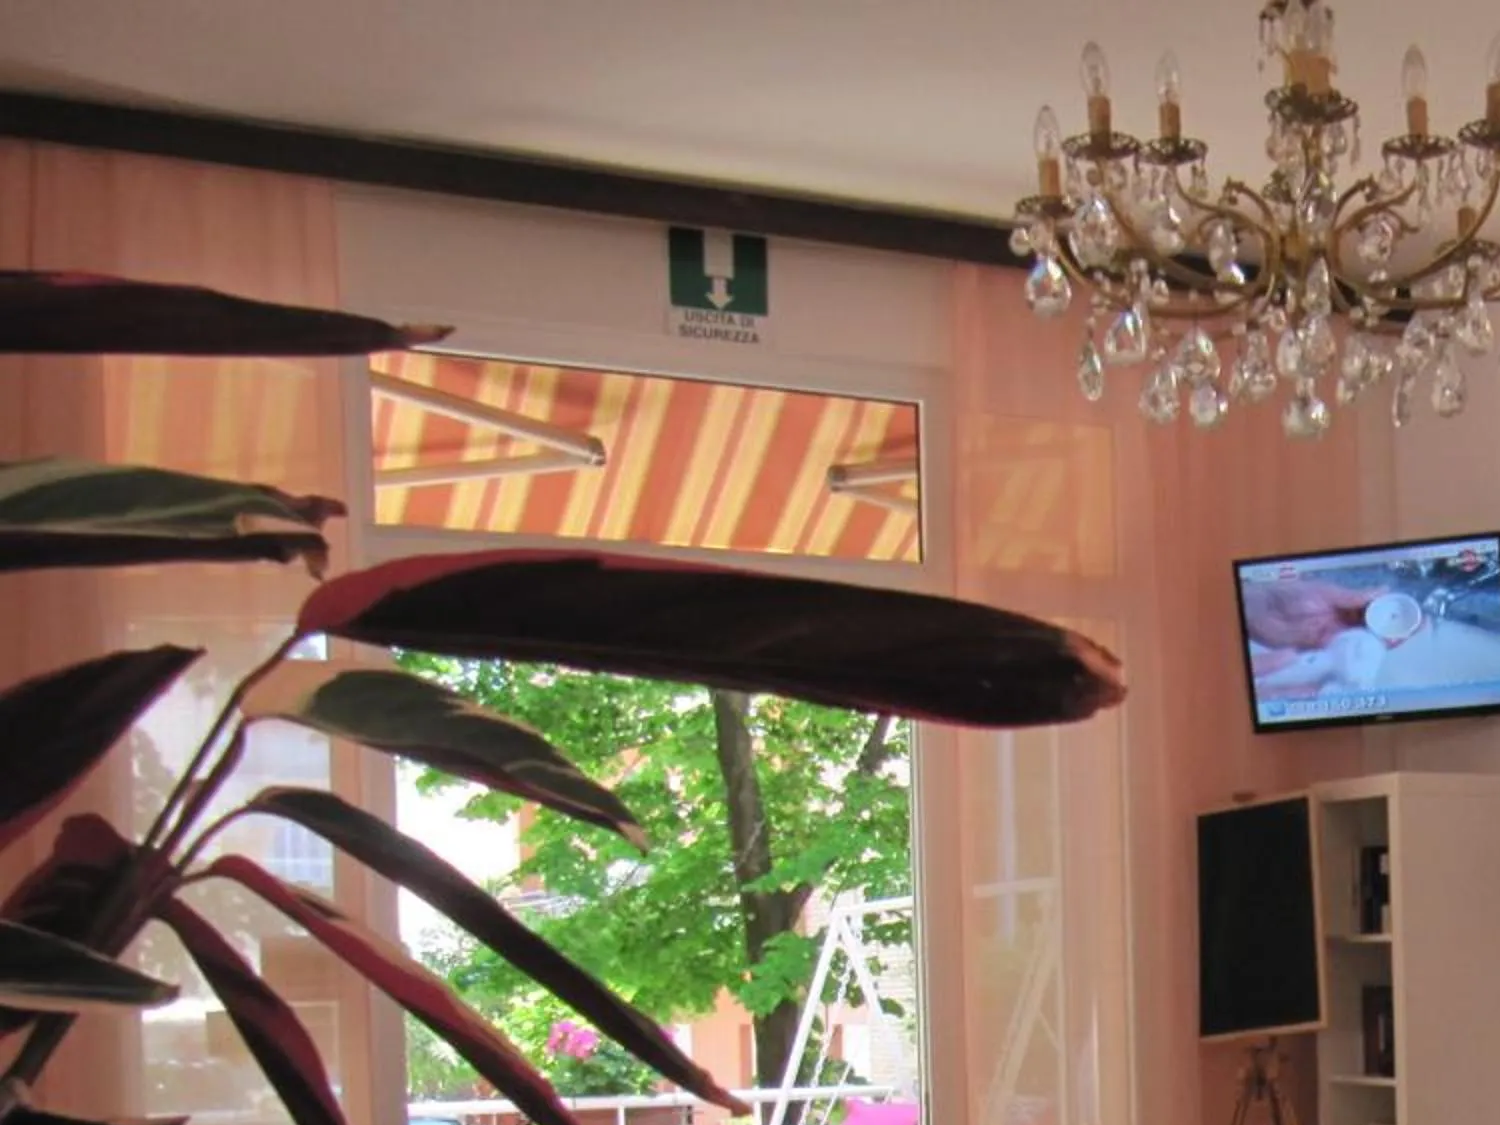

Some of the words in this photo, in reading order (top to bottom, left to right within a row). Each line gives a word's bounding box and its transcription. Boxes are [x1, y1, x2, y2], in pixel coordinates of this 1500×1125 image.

[684, 308, 737, 325] USCITA
[740, 314, 755, 328] DI
[678, 323, 760, 343] SICUREZZA
